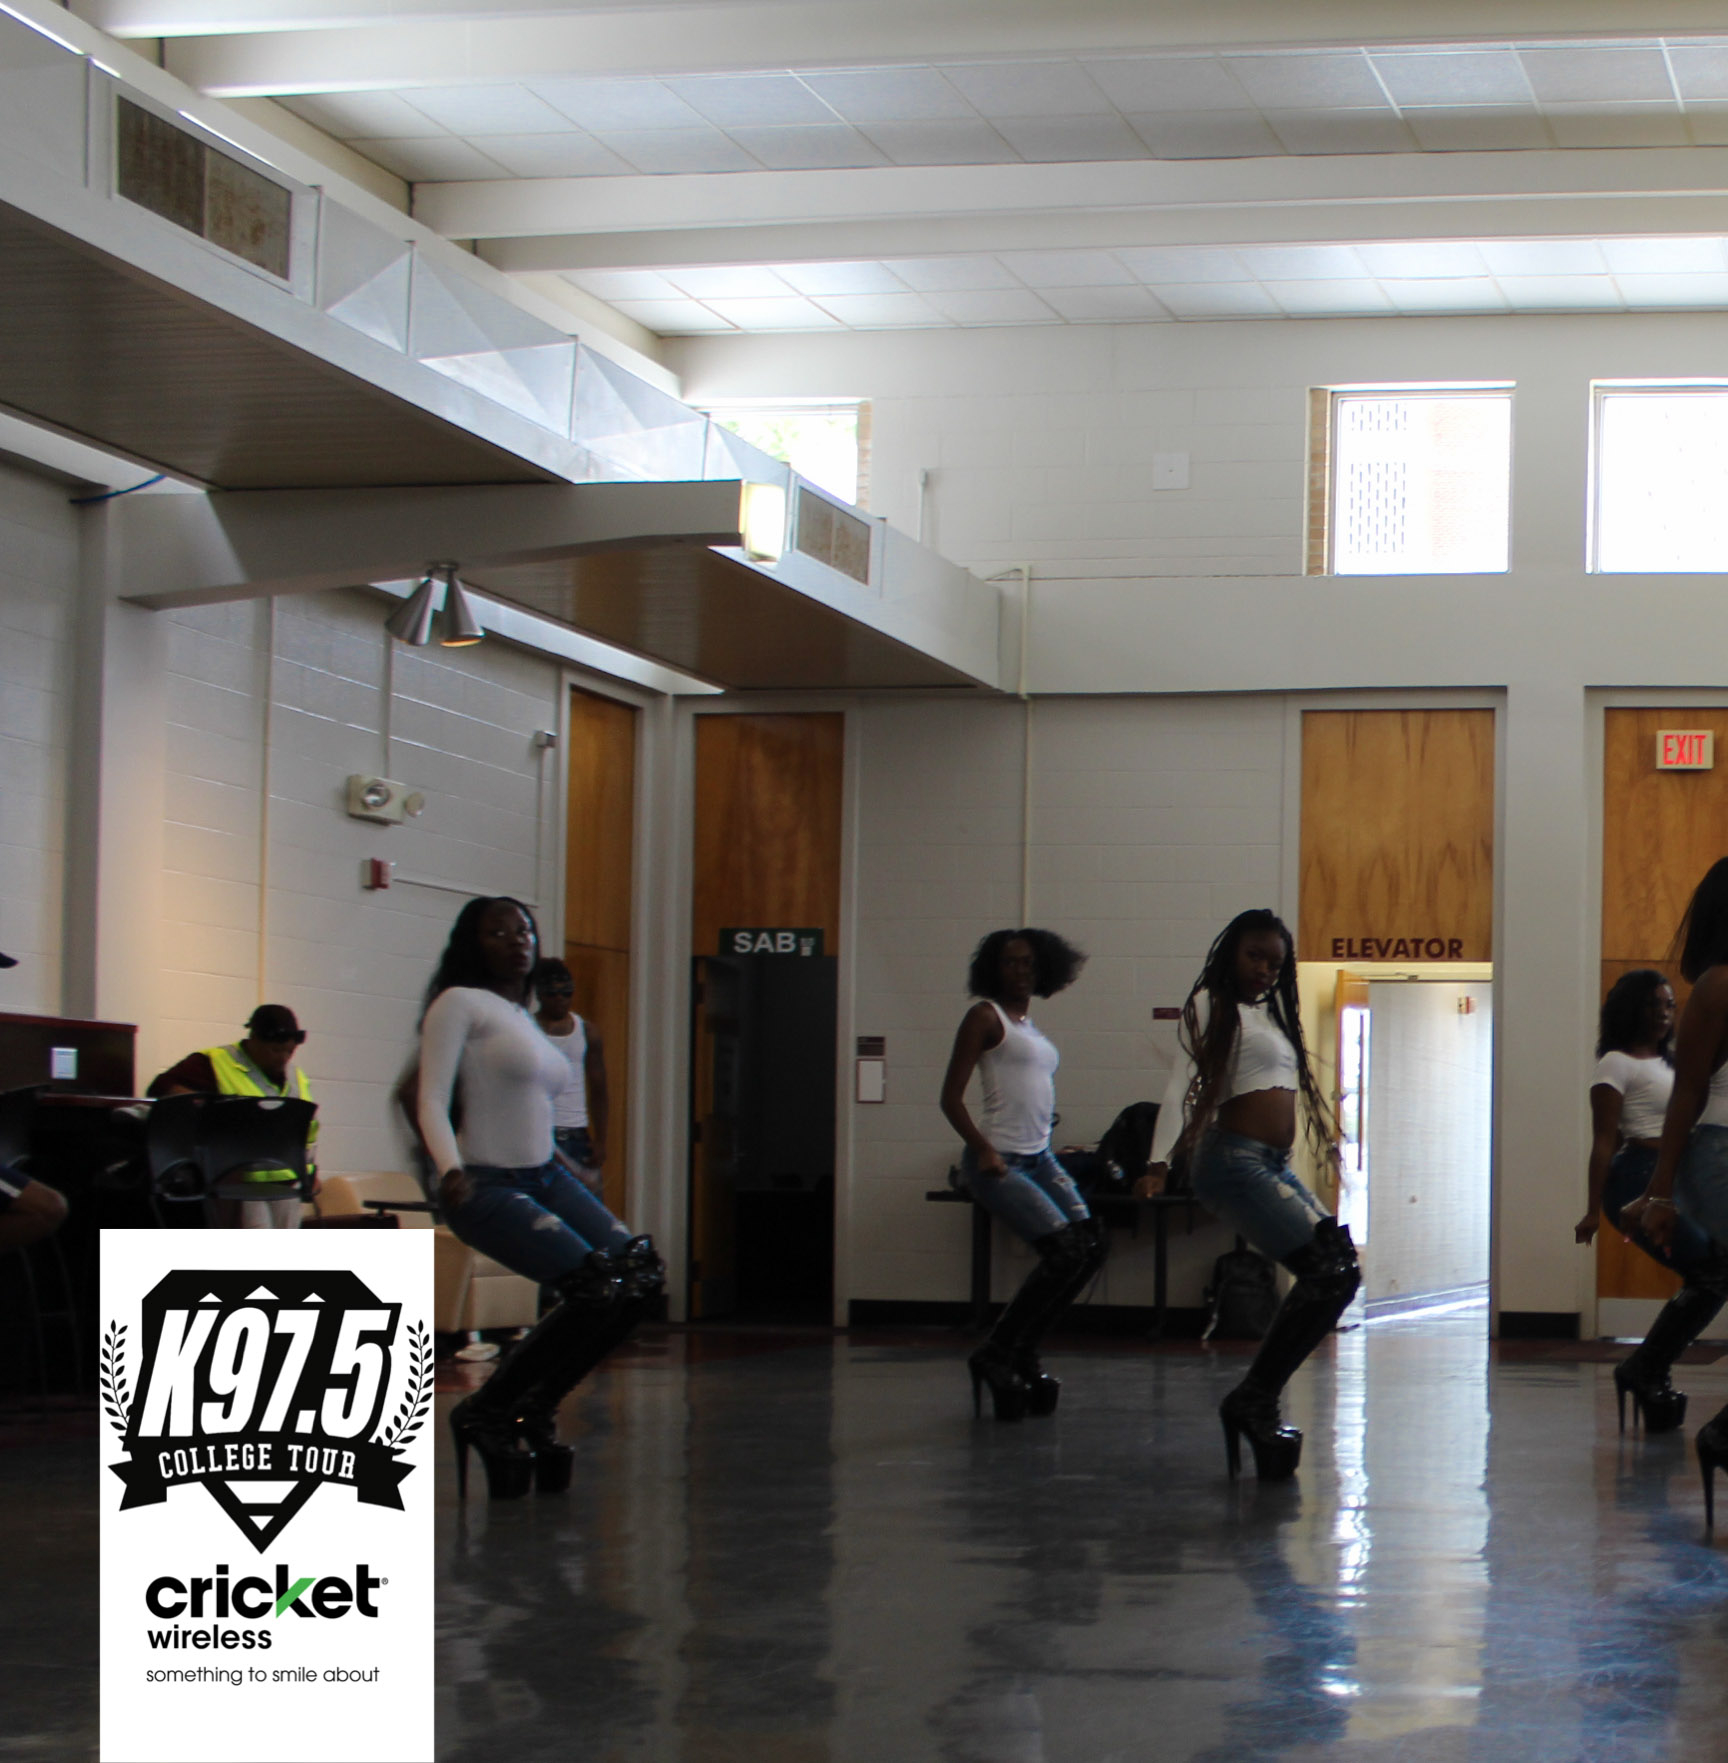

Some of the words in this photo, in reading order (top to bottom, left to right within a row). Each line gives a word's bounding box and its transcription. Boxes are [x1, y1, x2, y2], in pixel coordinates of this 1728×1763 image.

[1663, 734, 1707, 765] EXIT
[734, 931, 796, 953] SAB
[1331, 938, 1463, 958] ELEVATOR
